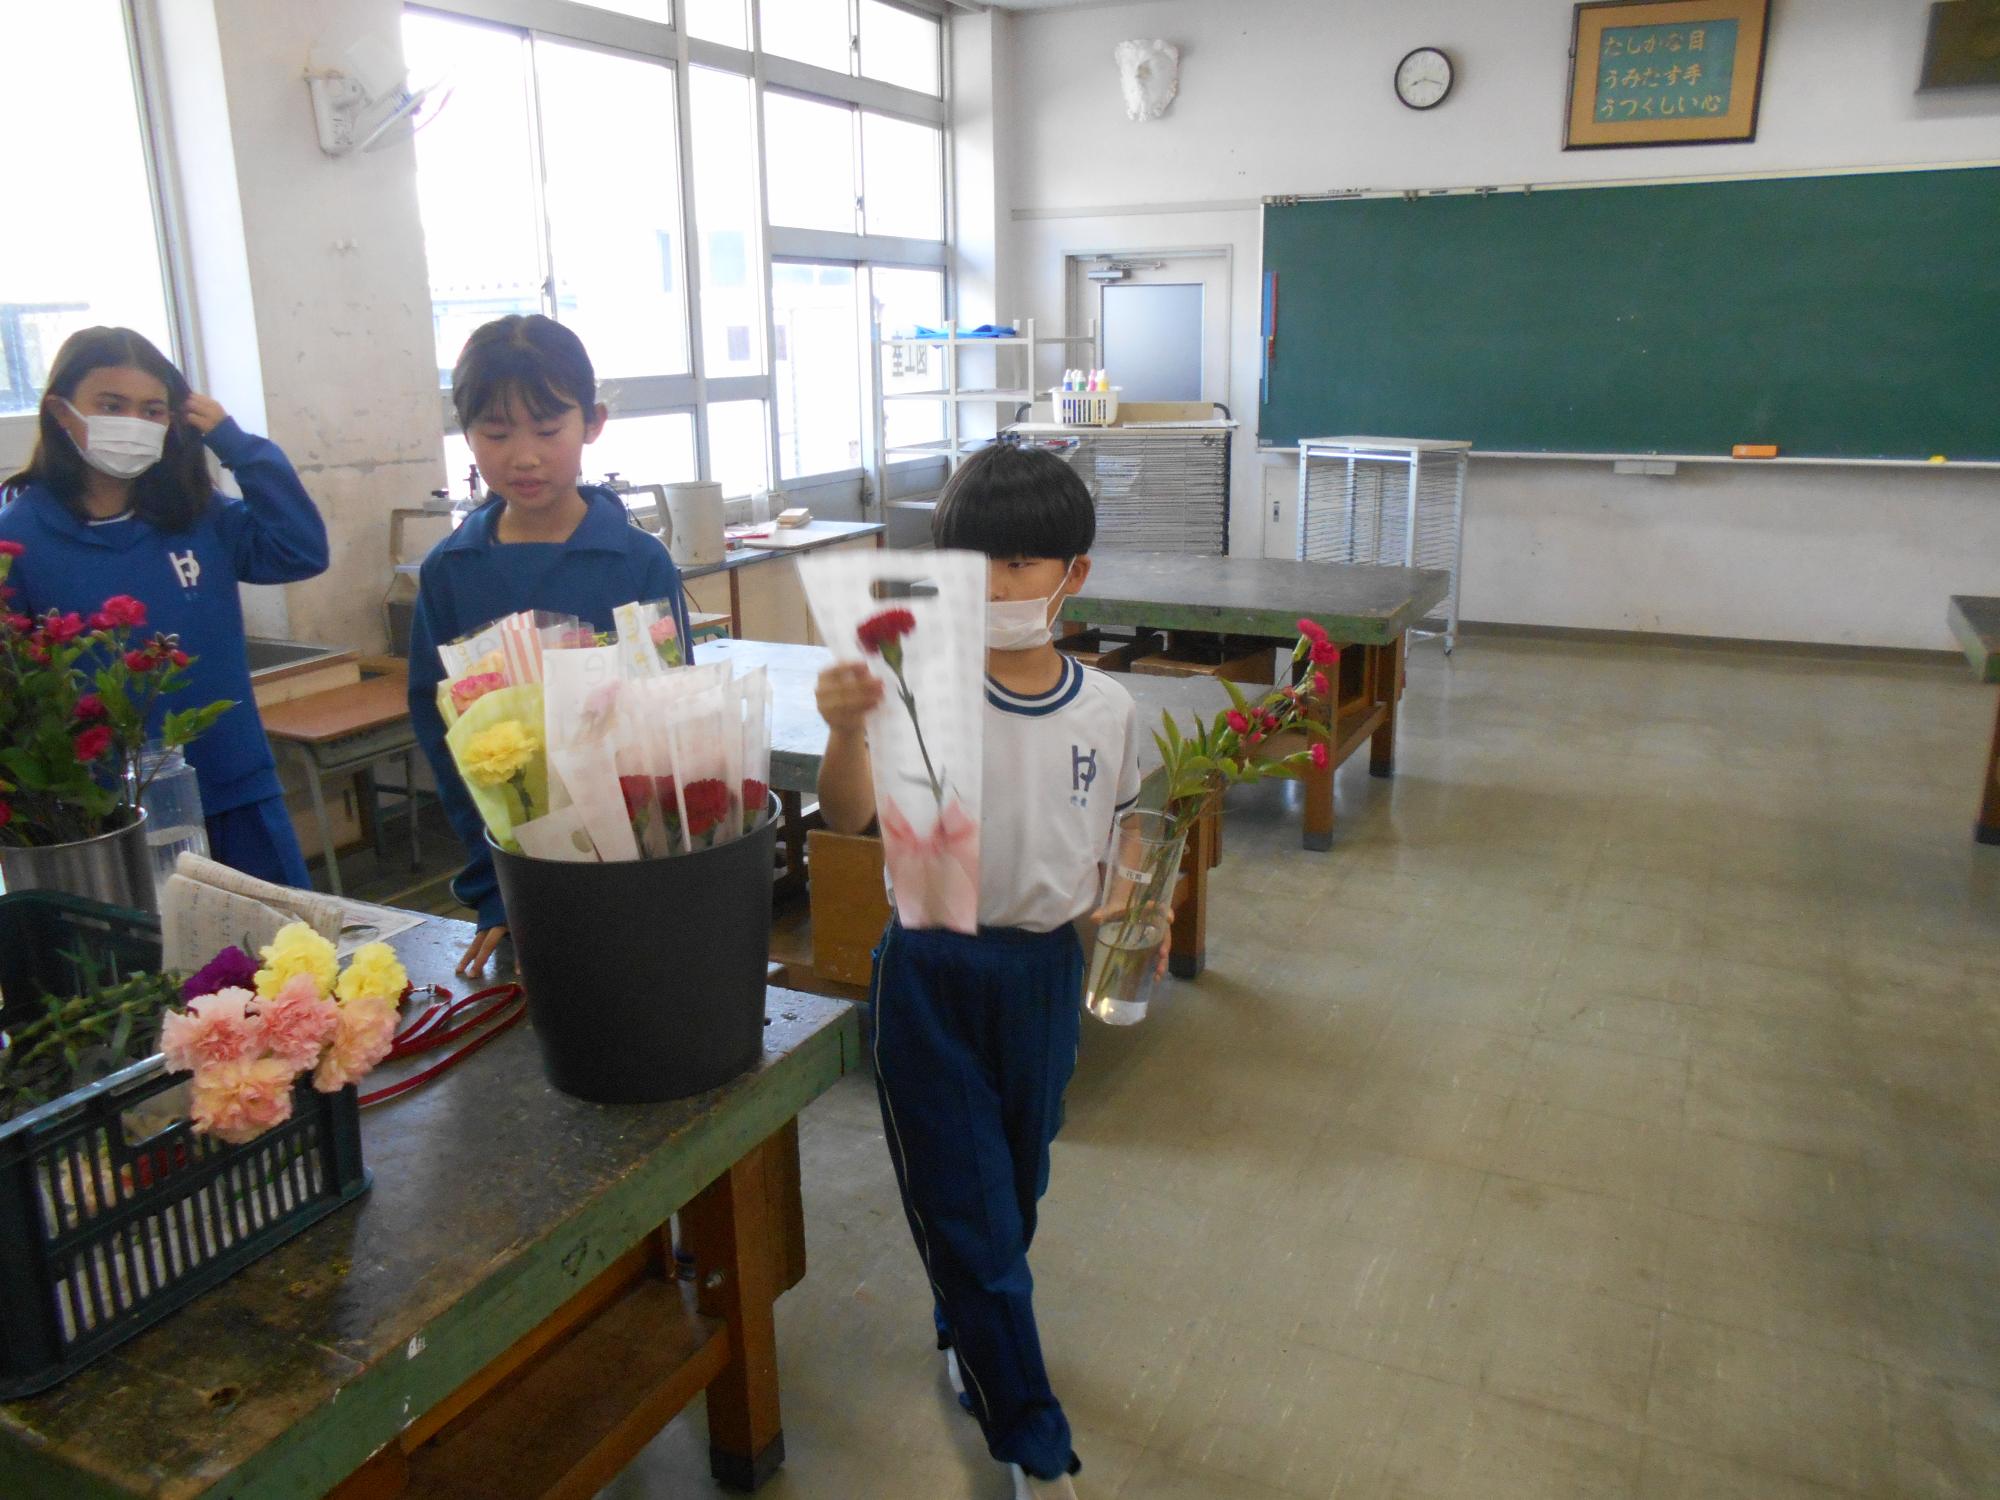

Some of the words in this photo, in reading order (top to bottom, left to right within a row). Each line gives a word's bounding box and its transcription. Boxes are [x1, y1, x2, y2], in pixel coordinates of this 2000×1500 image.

[1604, 30, 1705, 56] たしかな目
[1600, 94, 1722, 118] うつくしい心
